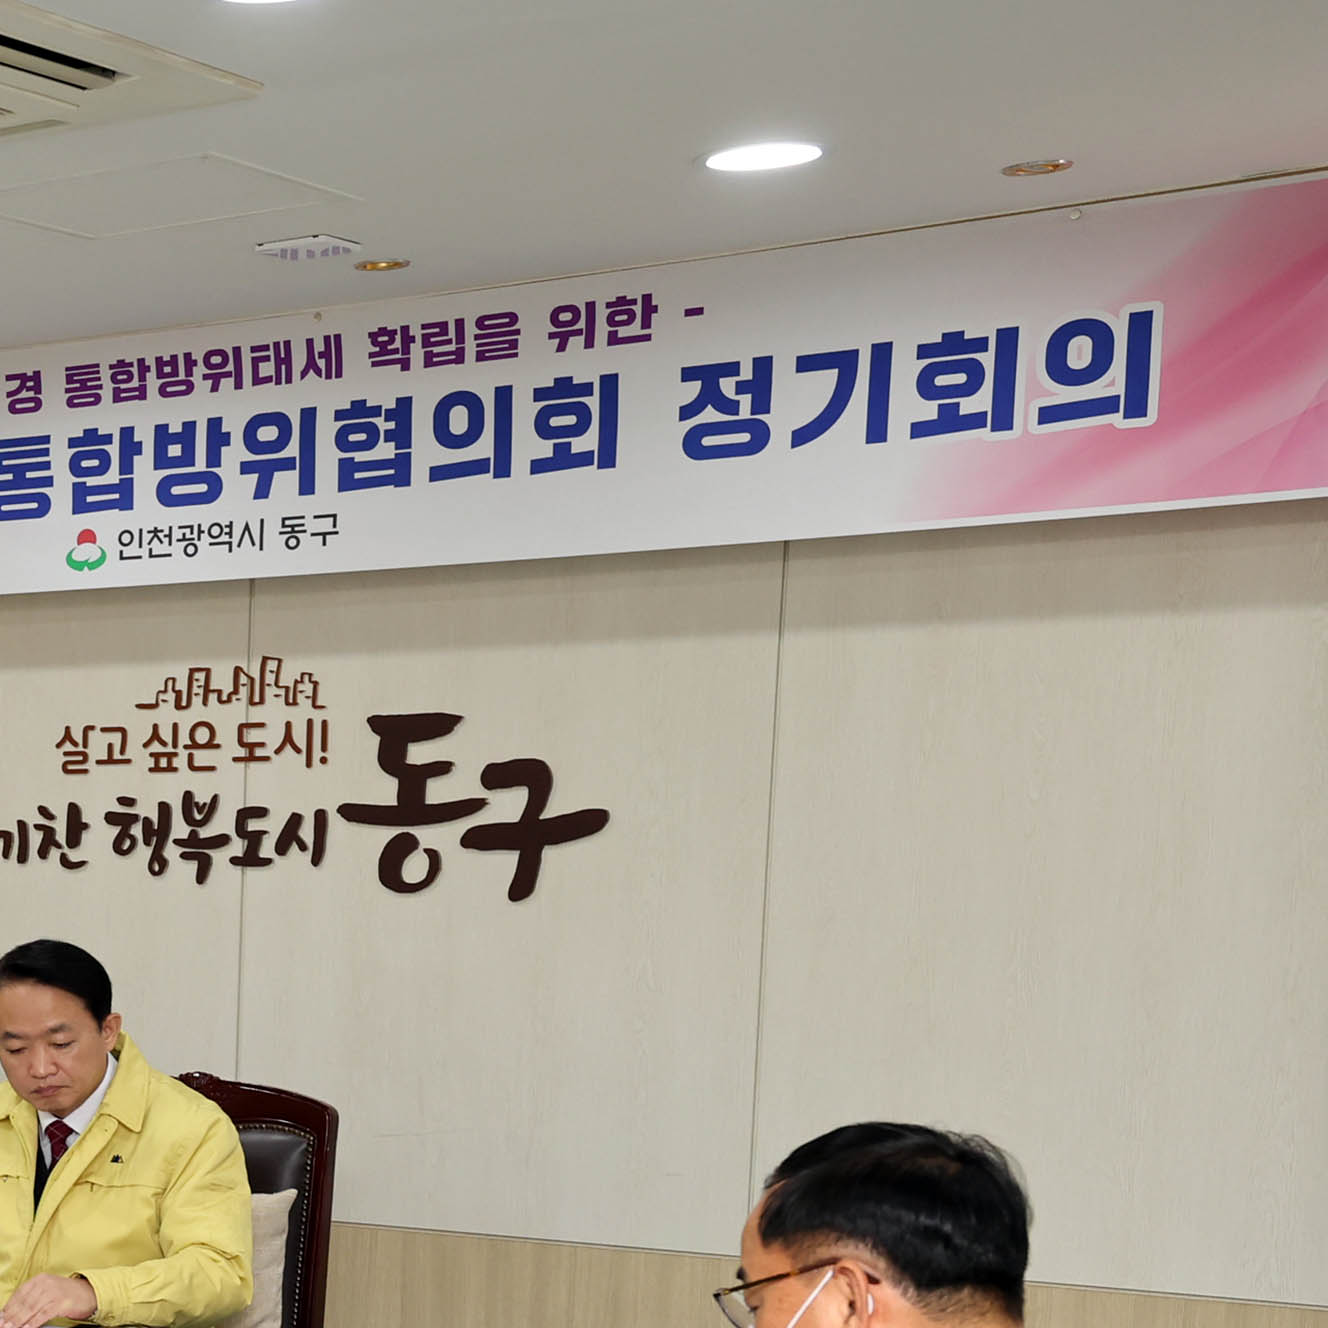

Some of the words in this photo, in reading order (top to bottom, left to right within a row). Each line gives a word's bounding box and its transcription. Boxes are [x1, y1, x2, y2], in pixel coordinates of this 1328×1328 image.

[64, 333, 343, 410] 통합방위태세
[367, 311, 522, 373] 확립을
[547, 293, 659, 354] 위한
[680, 310, 1154, 462] 정기회의
[117, 517, 265, 562] 인천광역시
[278, 513, 340, 552] 동구
[55, 724, 133, 775] 살고
[142, 720, 222, 774] 싶은
[231, 718, 329, 769] 도시!
[103, 789, 329, 886] 행복도시
[336, 712, 611, 903] 동구
